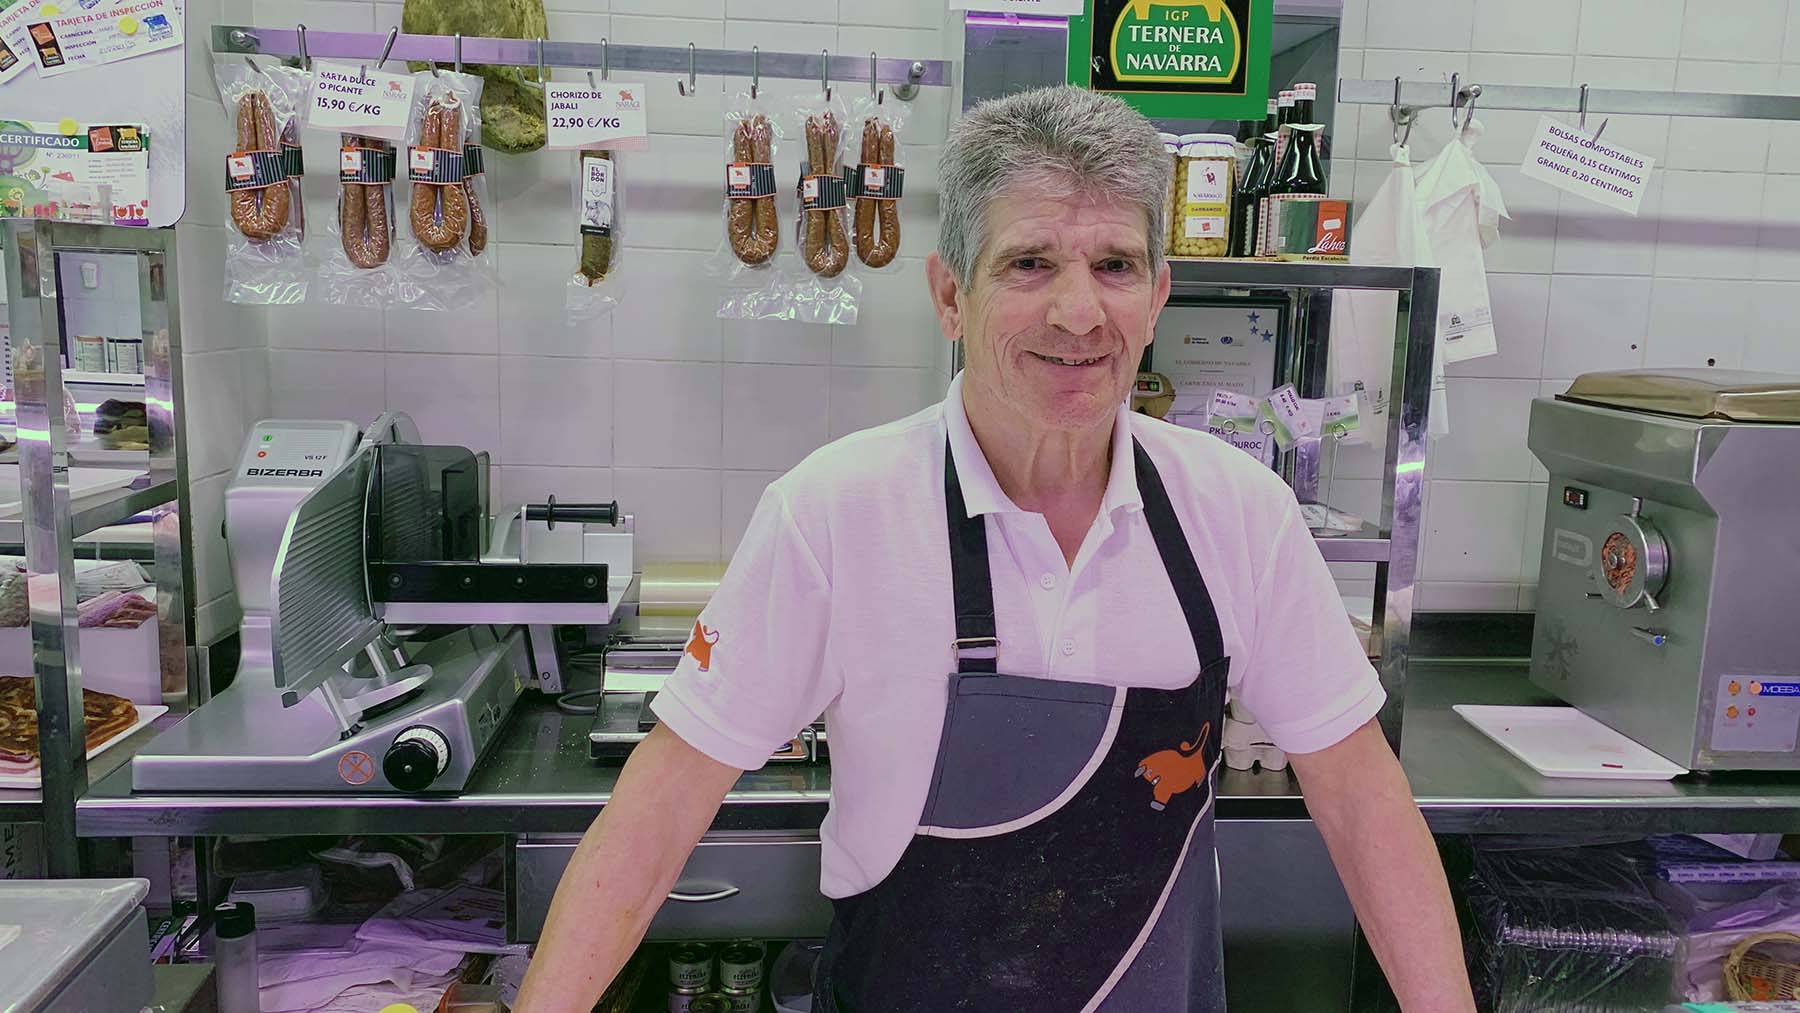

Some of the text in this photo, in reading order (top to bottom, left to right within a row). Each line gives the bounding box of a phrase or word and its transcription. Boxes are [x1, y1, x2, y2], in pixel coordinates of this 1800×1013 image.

[55, 15, 94, 27] TARJETA
[95, 12, 108, 21] DE
[1165, 10, 1190, 21] IGP
[1128, 25, 1224, 44] TERNERA
[1169, 44, 1182, 53] DE
[1126, 53, 1222, 72] NAVARRA
[320, 72, 376, 87] SARTA DULCE
[319, 82, 363, 95] O PICANTE
[550, 91, 602, 99] CHORIZO DE
[317, 97, 381, 115] 15,90 €/KG
[551, 102, 578, 110] JABALI
[552, 117, 620, 129] 22,90 €/KG
[0, 134, 80, 147] CERTIFICADO
[1549, 126, 1645, 169] BOLSAS COMPOSTABLES
[1540, 140, 1579, 161] PEQUEÑA
[1579, 155, 1597, 168] 0,15
[1537, 156, 1634, 198] GRANDE 0,20 CENTIMOS
[247, 468, 323, 477] BIZERBA
